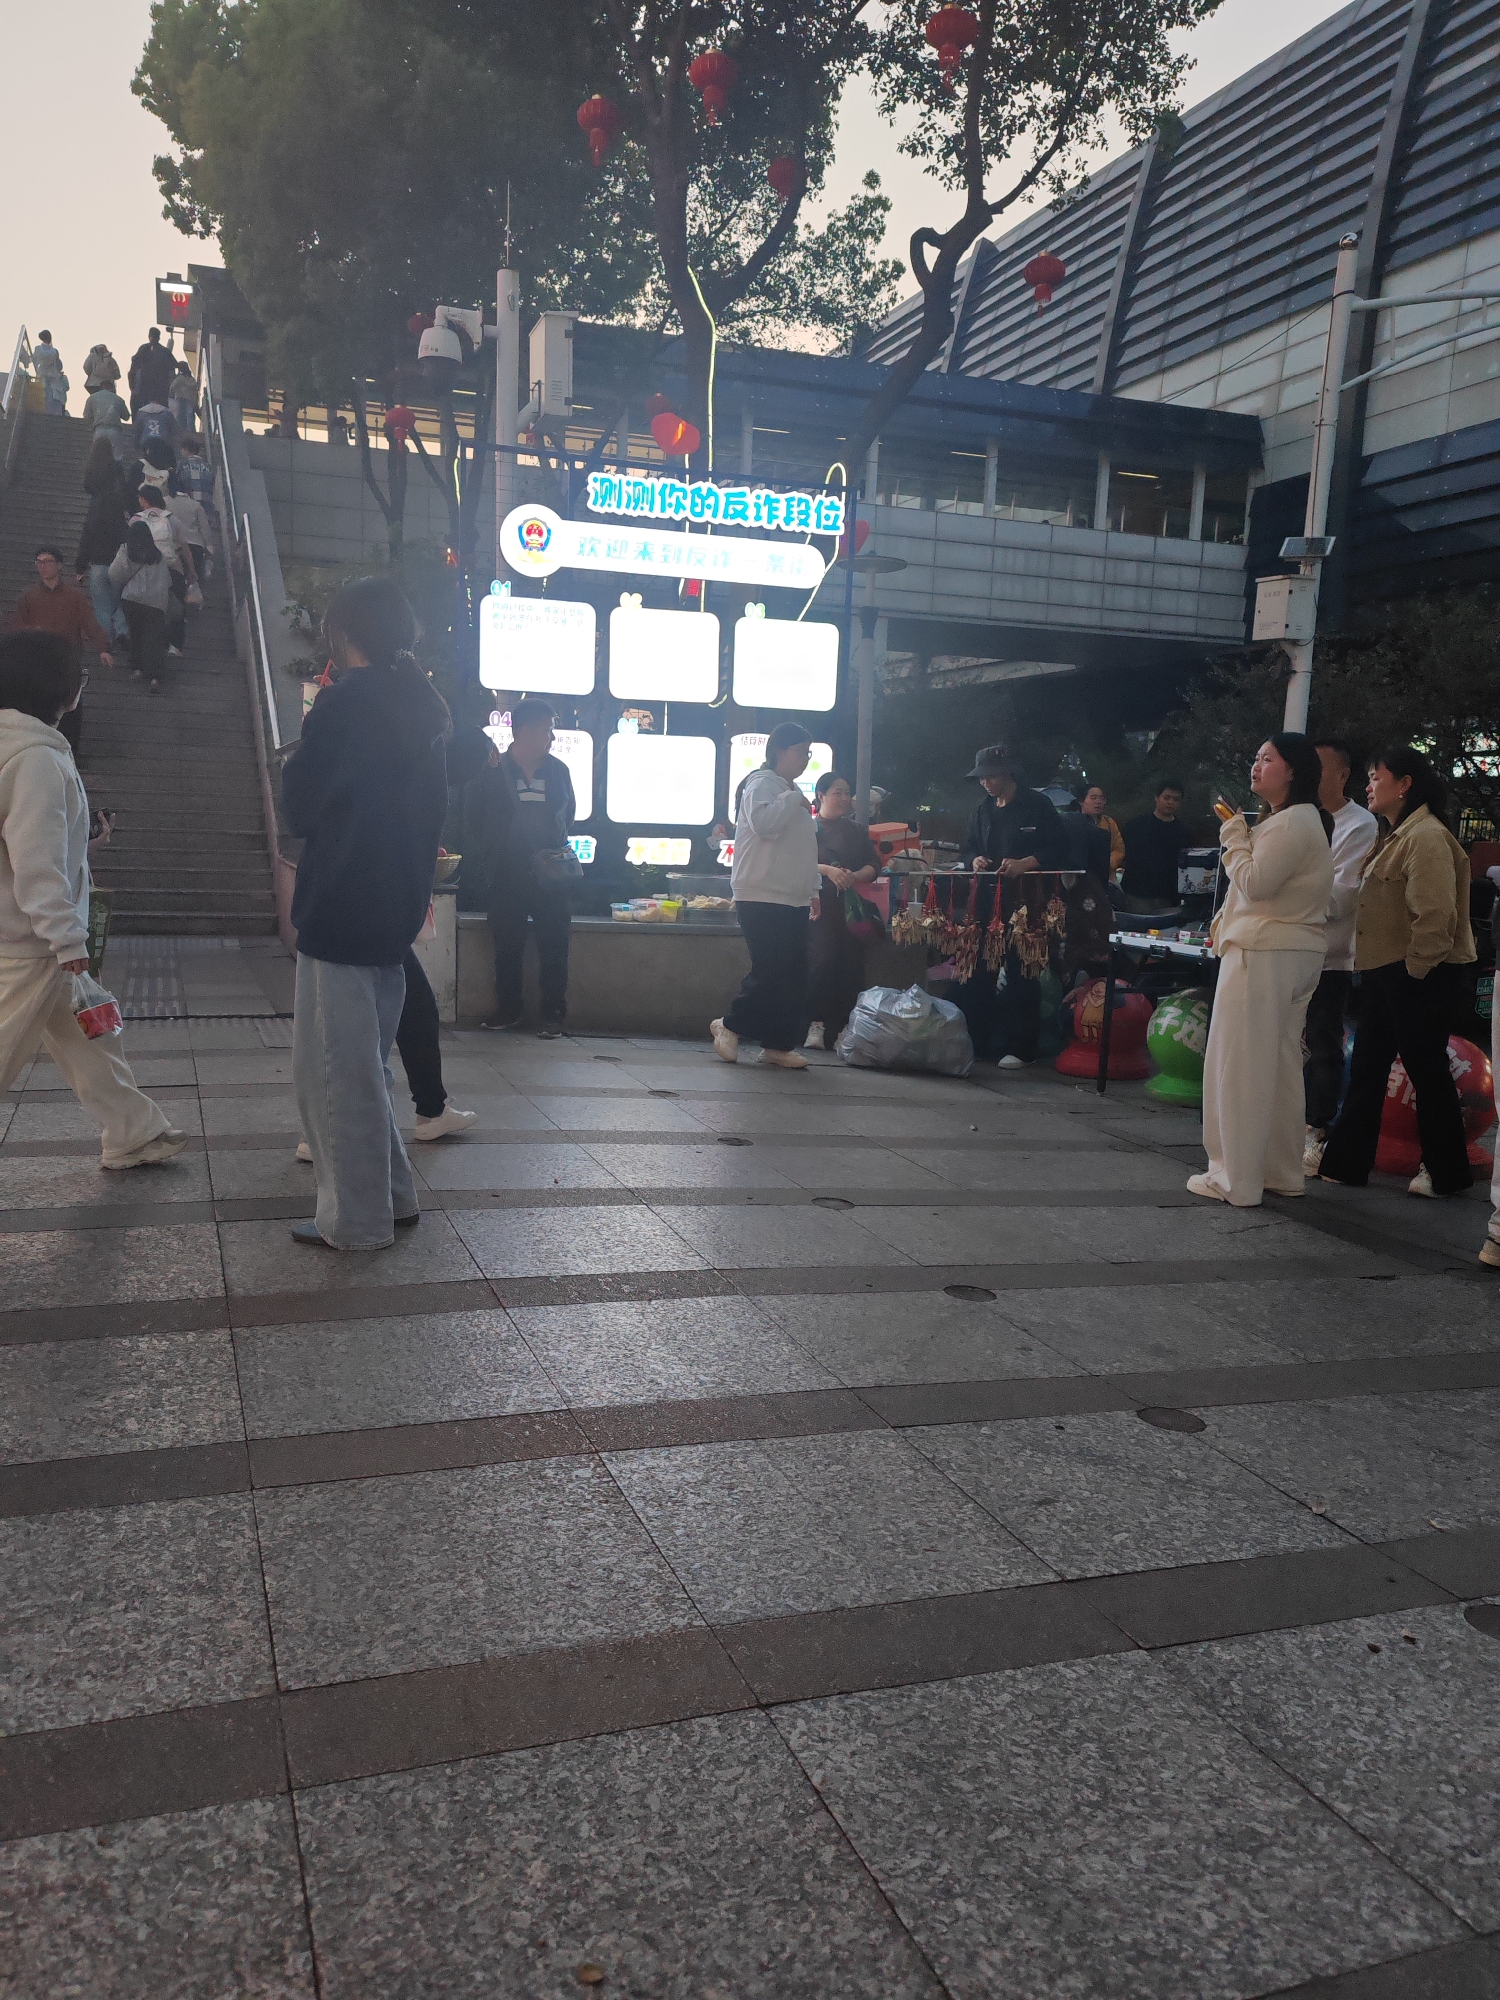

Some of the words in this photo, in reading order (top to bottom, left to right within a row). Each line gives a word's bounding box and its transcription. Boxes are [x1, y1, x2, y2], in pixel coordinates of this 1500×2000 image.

[591, 476, 842, 532] 测测你的反诈段位
[491, 580, 511, 597] 01
[489, 711, 512, 727] 04
